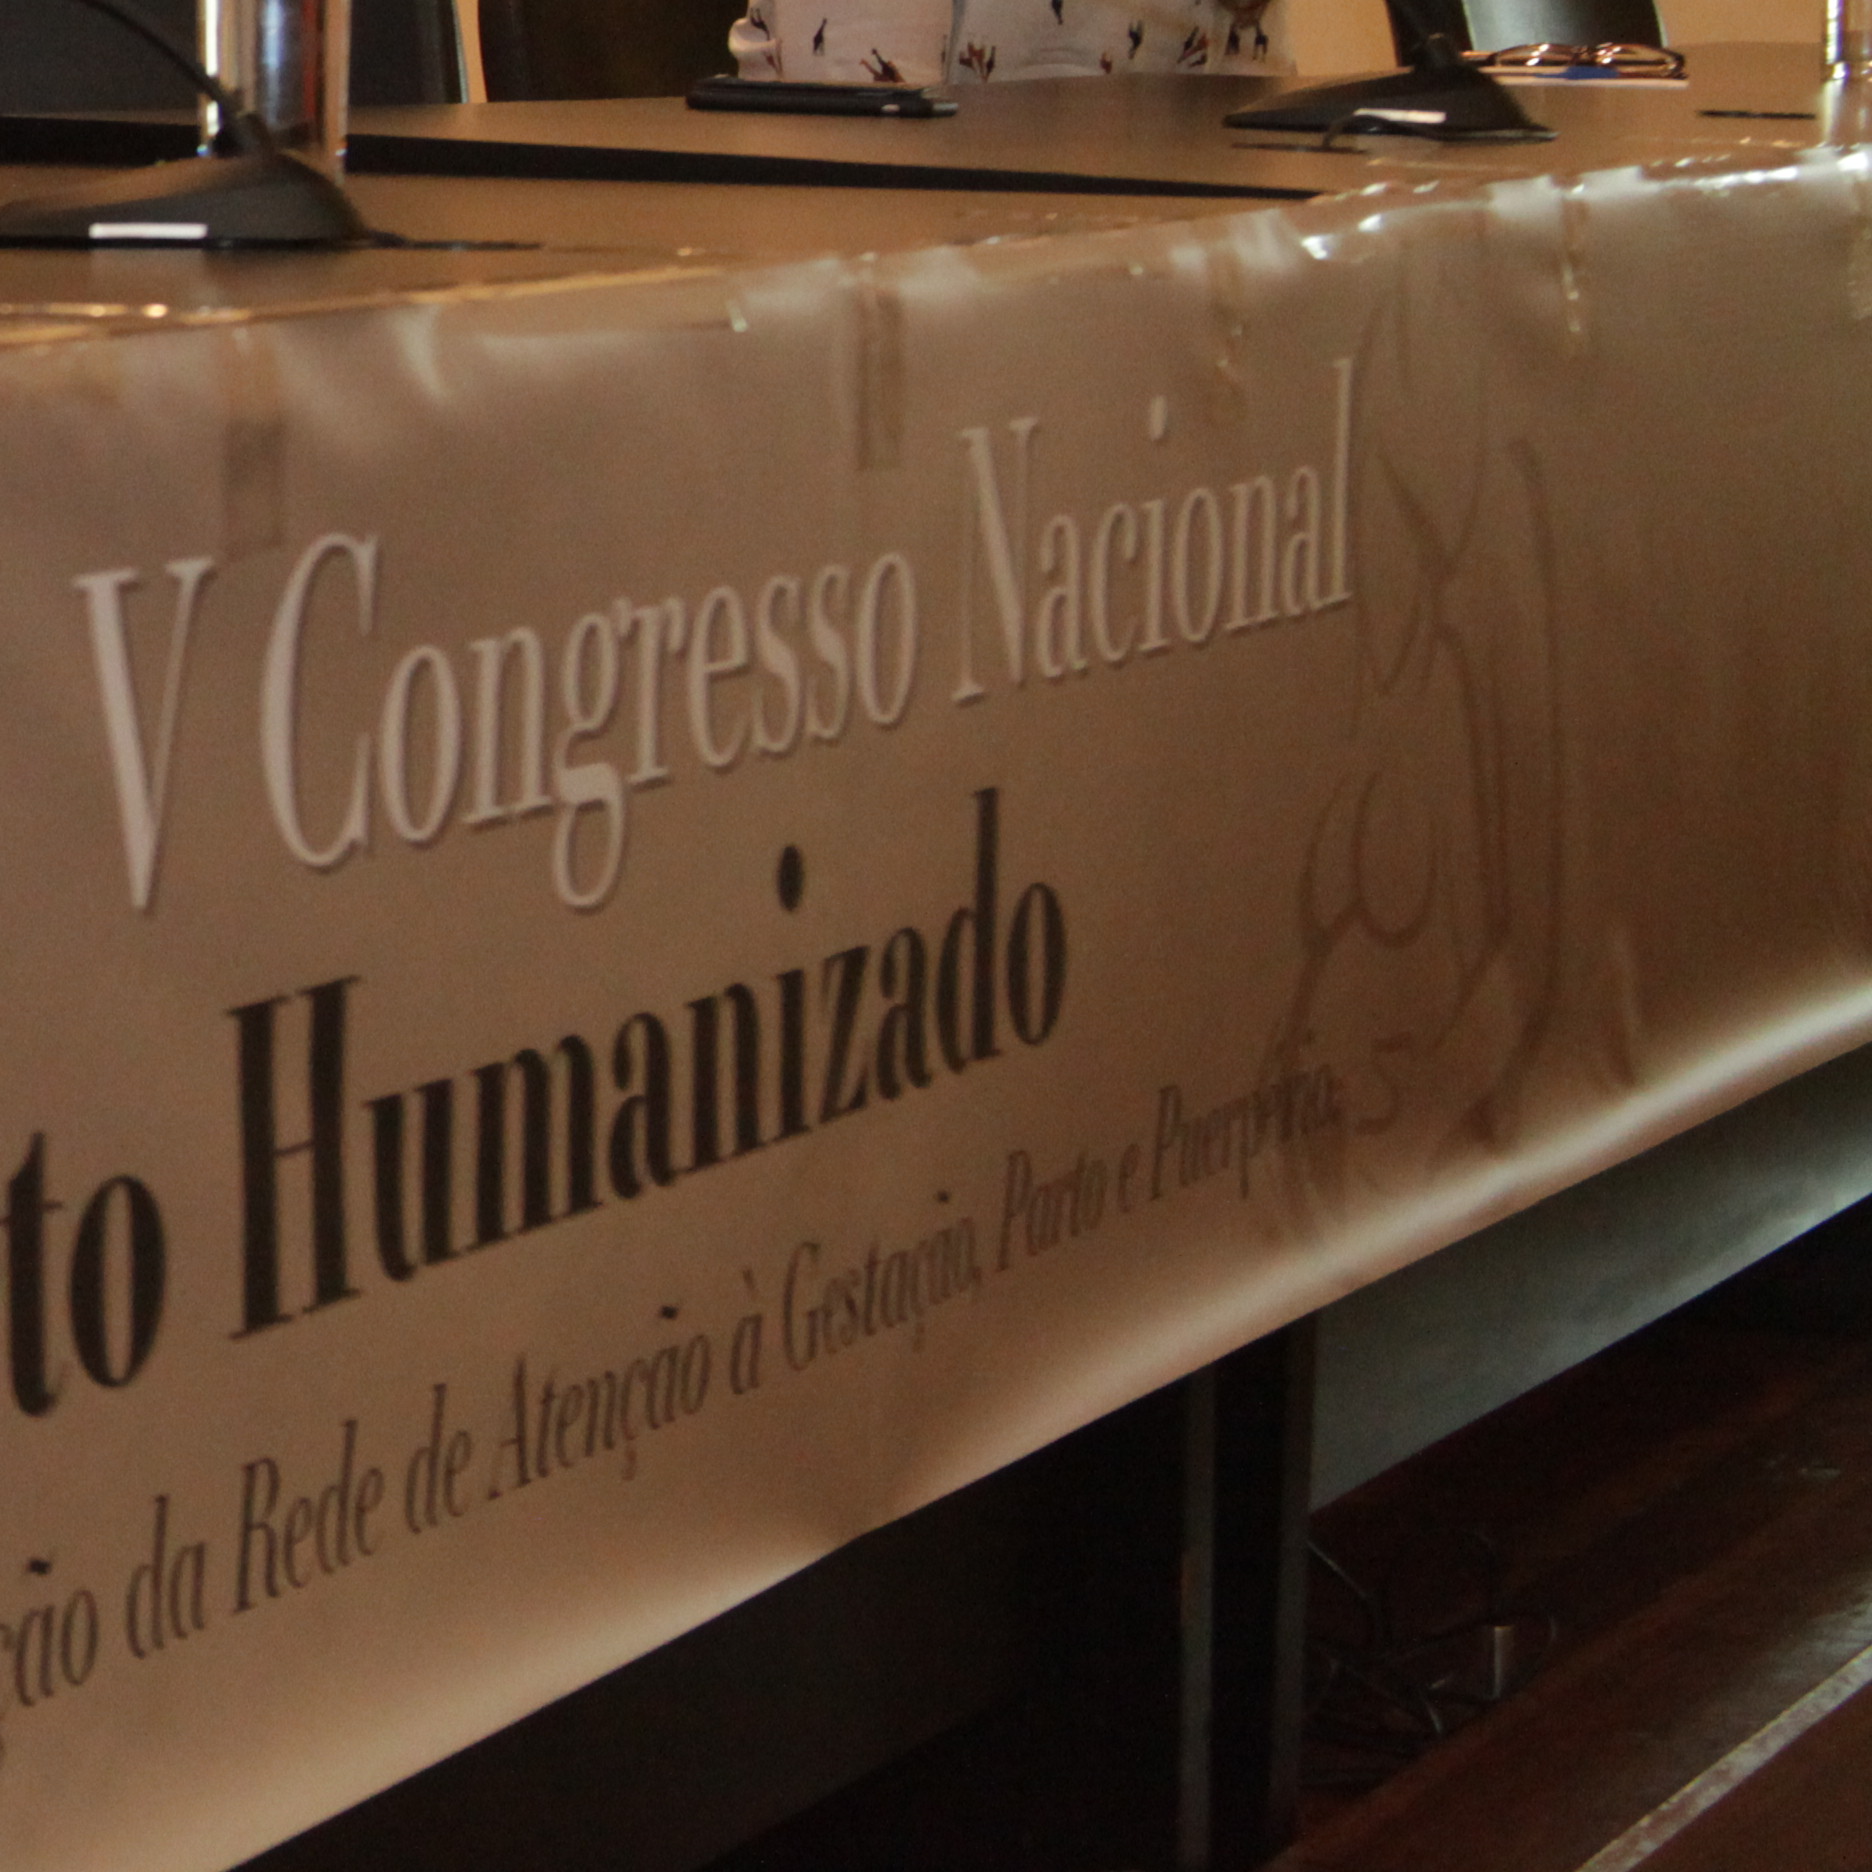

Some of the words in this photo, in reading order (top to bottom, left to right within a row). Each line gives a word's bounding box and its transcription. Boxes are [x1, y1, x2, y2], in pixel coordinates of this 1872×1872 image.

[73, 557, 216, 911] V
[260, 532, 916, 911] Congresso
[952, 357, 1353, 705] Nacional
[226, 786, 1068, 1342] Humanizado
[124, 1494, 207, 1661] da
[231, 1418, 385, 1616] Rede
[403, 1382, 473, 1535] de
[485, 1304, 712, 1502] Atenção
[996, 1149, 1109, 1273] Parto
[1116, 1144, 1141, 1215] e
